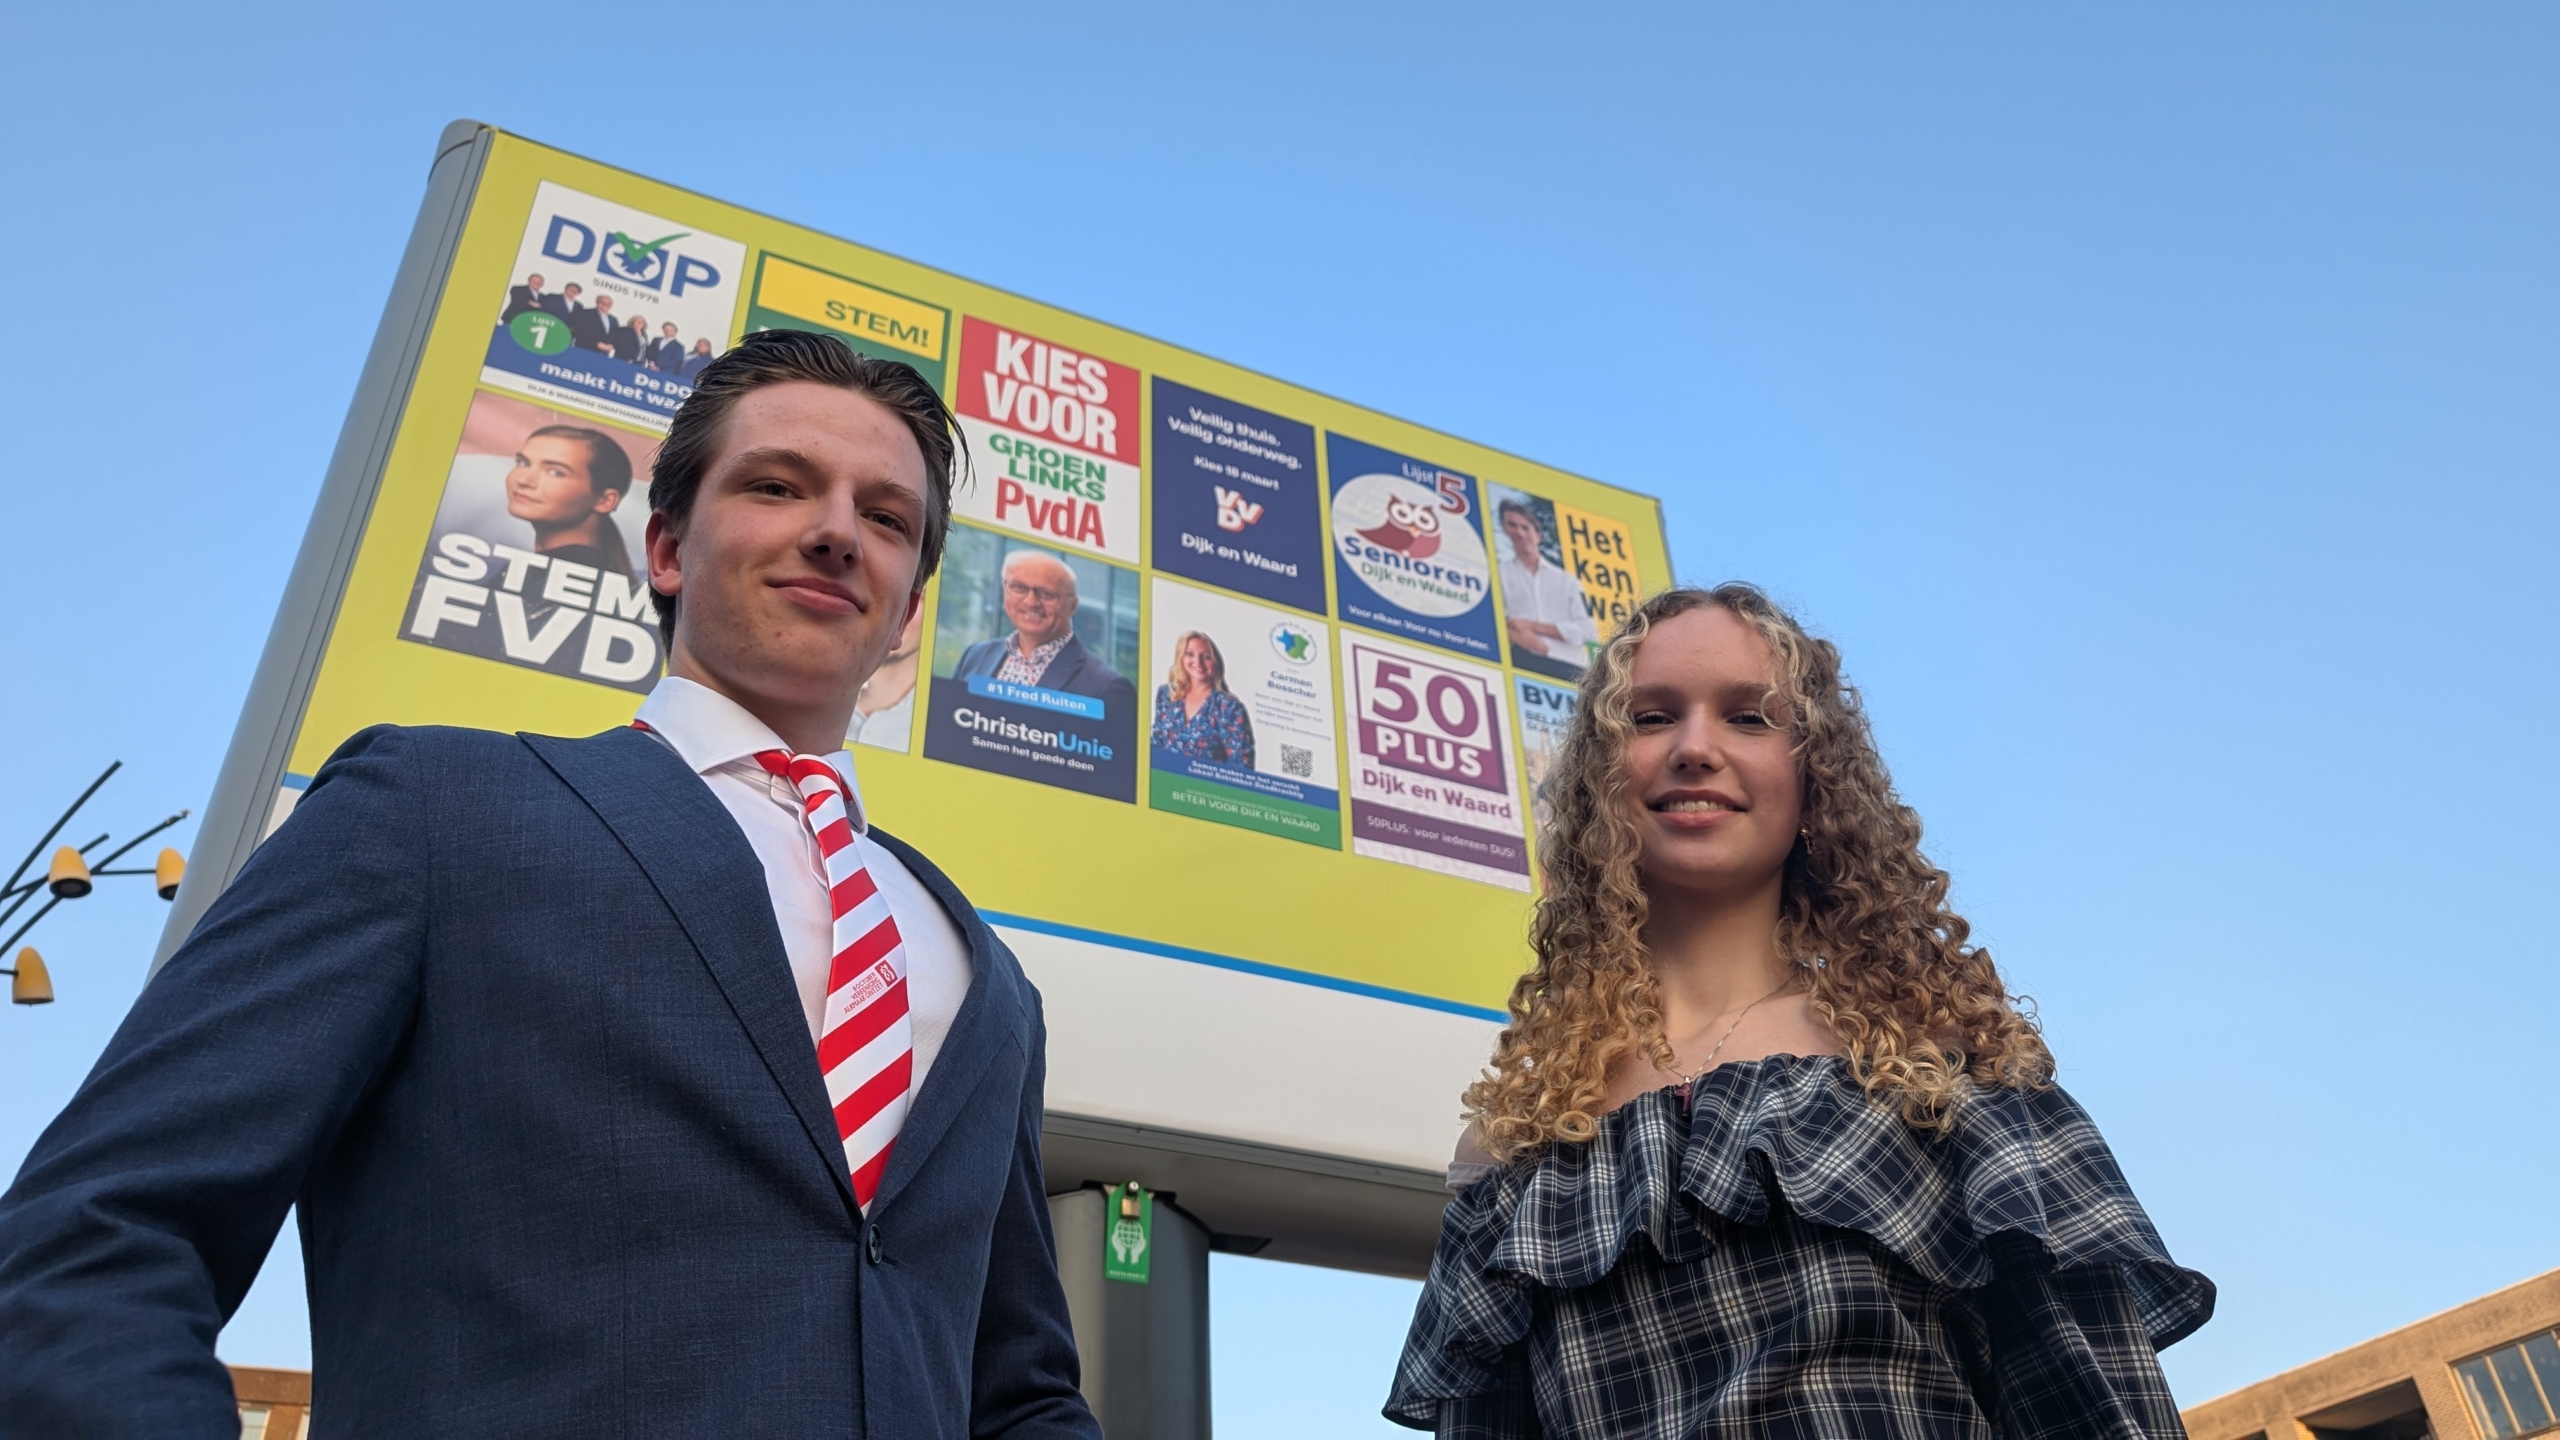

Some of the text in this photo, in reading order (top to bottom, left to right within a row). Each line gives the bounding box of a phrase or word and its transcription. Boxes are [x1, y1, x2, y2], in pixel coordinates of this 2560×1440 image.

[592, 277, 660, 304] SINDS 1978
[530, 325, 548, 349] 1
[532, 315, 556, 328] LIJST
[824, 299, 929, 348] STEM!
[540, 362, 686, 411] maakt het waa
[634, 372, 692, 400] De DO
[996, 329, 1108, 405] KIES
[983, 370, 1117, 455] VOOR
[1188, 405, 1234, 434] Veilig
[989, 433, 1107, 483] GROEN
[1167, 415, 1302, 470] Veilig onderweg.
[1008, 458, 1106, 502] LINKS
[1193, 455, 1280, 491] Kies 18 maart
[1402, 462, 1436, 485] Lijst
[1437, 471, 1470, 517] 5
[995, 477, 1106, 548] PvdA
[1180, 532, 1297, 578] Dijk en Waard
[1566, 514, 1627, 560] Het
[432, 532, 660, 626] STEM
[1344, 535, 1482, 592] Senioren
[1360, 562, 1470, 603] Dijk en Waard
[1572, 548, 1634, 595] kan
[410, 574, 656, 683] FVD
[1347, 603, 1371, 618] Voor
[986, 681, 1087, 711] #1 Fred Ruiten
[1267, 679, 1317, 699] Bosscher
[1270, 670, 1313, 687] Carmen
[1372, 658, 1480, 739] 50
[953, 707, 1114, 761] ChristenUnie
[971, 735, 1094, 772] Samen het goede doen
[1376, 725, 1482, 778] PLUS
[1187, 766, 1214, 778] Lokaal
[1191, 760, 1218, 772] Samen
[1220, 767, 1245, 779] maken
[1258, 775, 1270, 784] het
[1172, 791, 1320, 832] BETER VOOR DIJK EN WAARD
[1362, 768, 1512, 820] Dijk en Waard
[1366, 815, 1412, 834] 50PLUS:
[1415, 827, 1440, 840] voor
[1441, 829, 1488, 851] iedereen
[856, 972, 877, 989] OCTOBER
[843, 995, 866, 1014] ALKMAAR
